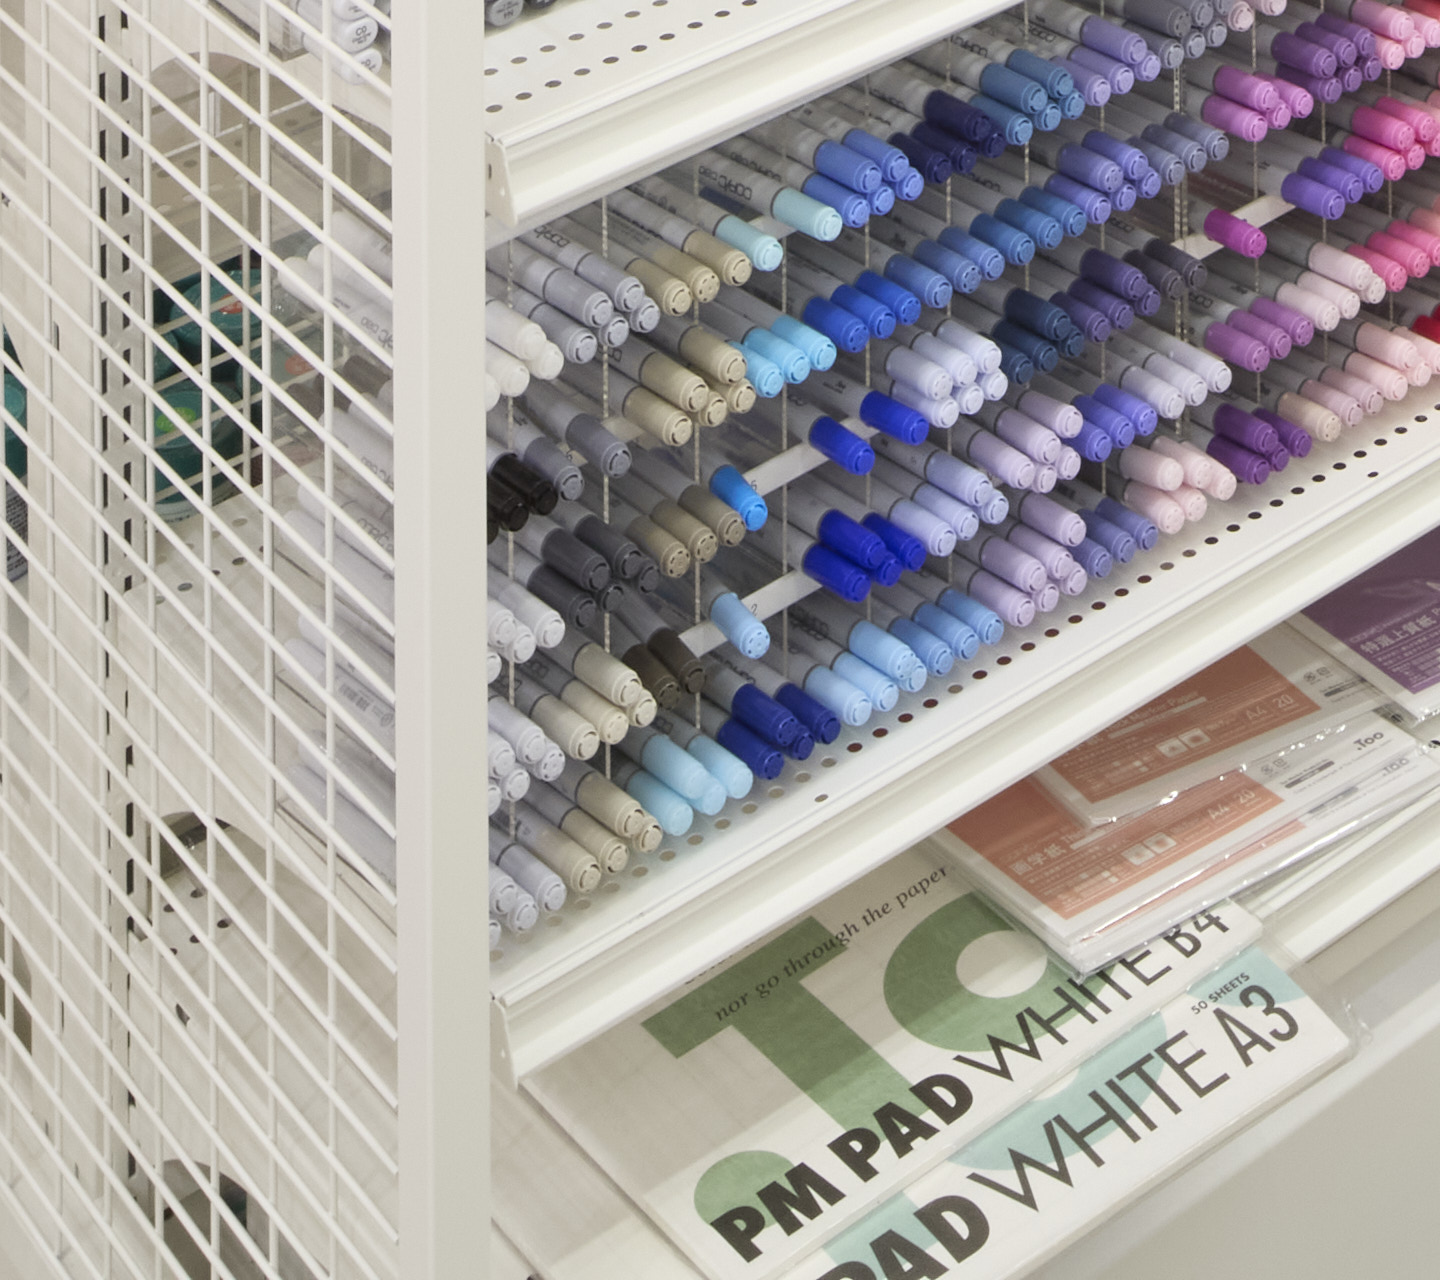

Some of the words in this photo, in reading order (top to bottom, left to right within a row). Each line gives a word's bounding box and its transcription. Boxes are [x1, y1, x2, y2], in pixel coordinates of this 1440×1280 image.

[1244, 701, 1269, 724] A4
[1274, 691, 1296, 711] 20
[1007, 840, 1068, 876] 画学紙
[713, 994, 753, 1023] nor
[754, 973, 780, 1001] go
[781, 916, 860, 988] through
[860, 897, 895, 933] the
[1189, 996, 1210, 1016] 50
[1206, 971, 1251, 1006] SHEETS
[710, 1161, 847, 1264] PM
[826, 1072, 974, 1183] PAD
[952, 947, 1174, 1083] WHITE
[1160, 905, 1230, 959] B4
[965, 1030, 1231, 1214] WHITE
[1212, 982, 1301, 1069] A3
